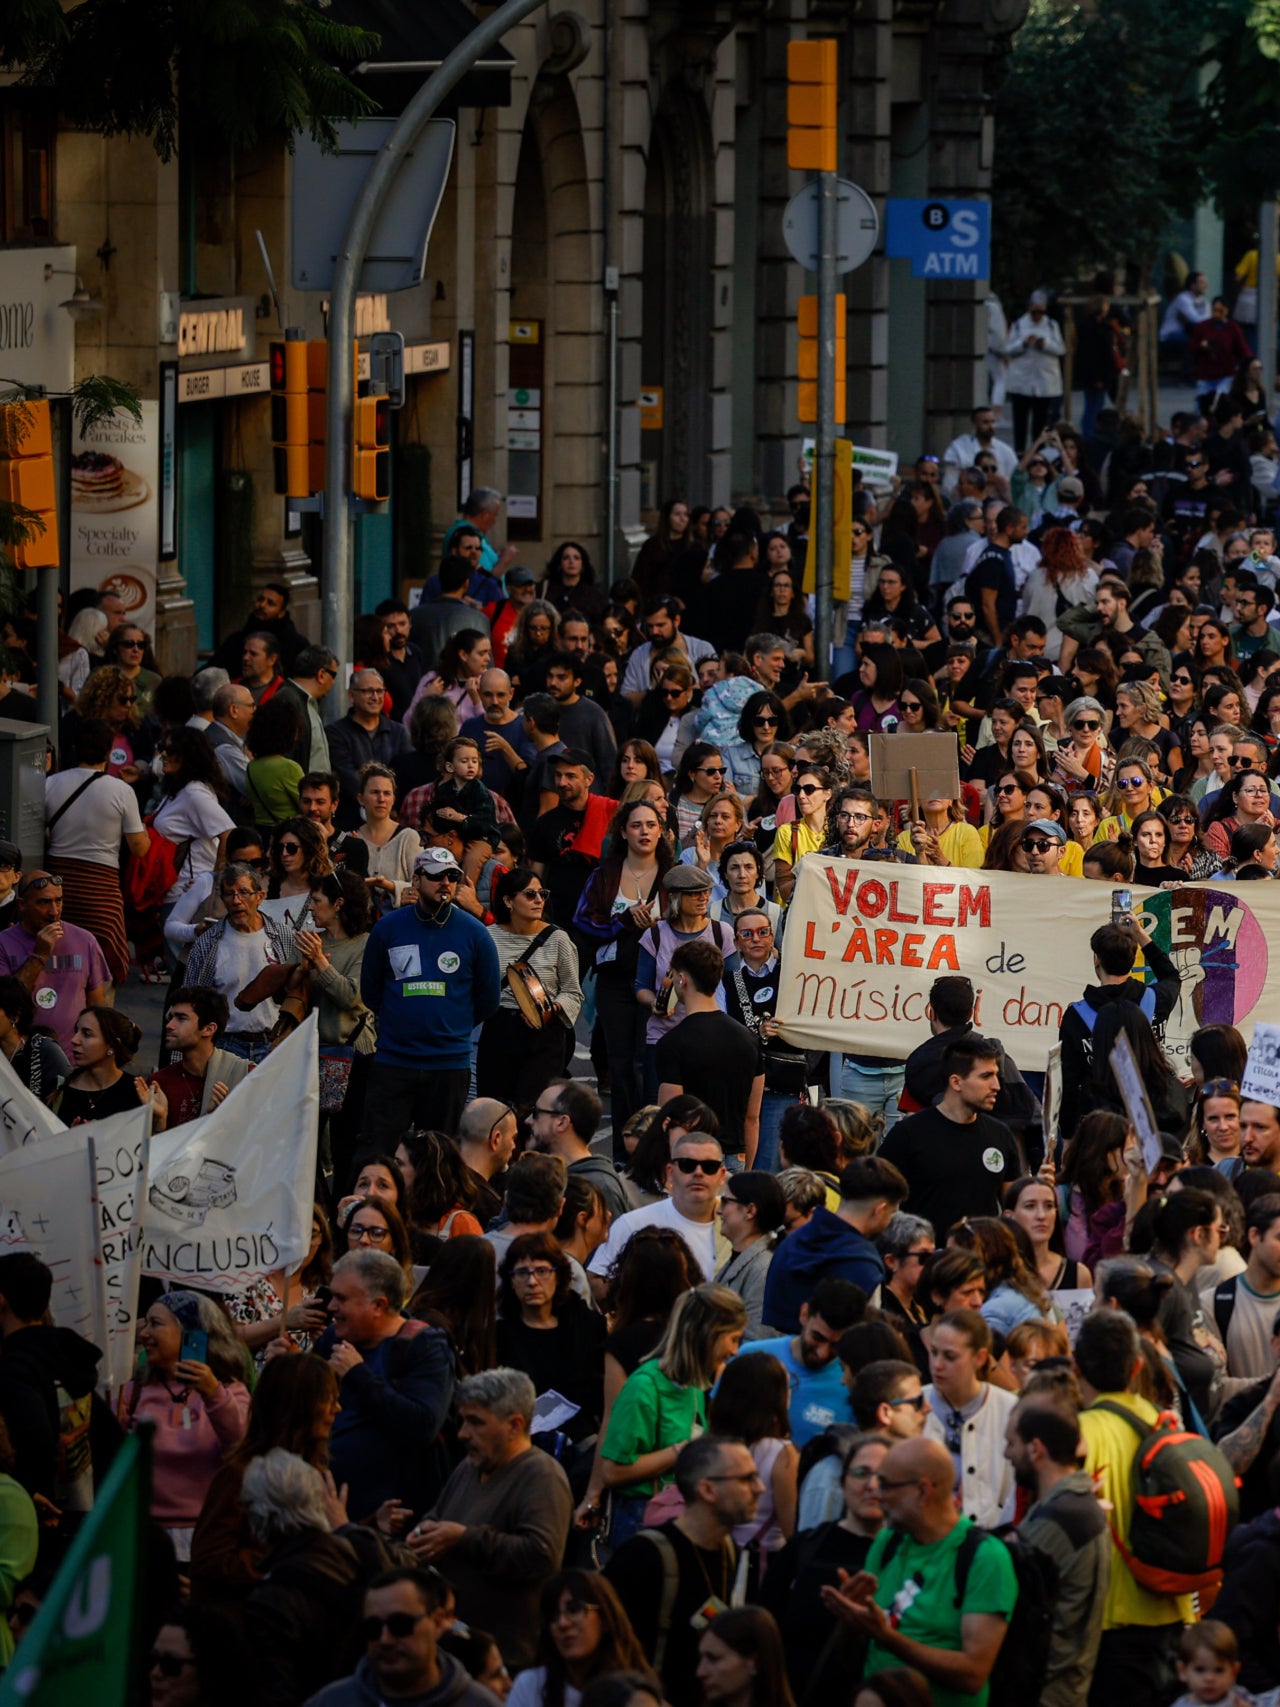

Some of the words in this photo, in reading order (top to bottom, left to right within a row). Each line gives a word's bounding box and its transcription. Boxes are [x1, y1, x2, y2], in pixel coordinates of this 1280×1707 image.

[924, 251, 979, 275] ATM
[178, 308, 247, 357] CENTRAL
[186, 375, 210, 396] BURGER
[241, 368, 261, 388] HOUSE
[78, 526, 139, 547] Specialty
[86, 540, 132, 558] Coffee
[824, 866, 992, 928] VOLEM
[804, 915, 961, 971] L'ÀREA
[985, 941, 1027, 974] de
[796, 972, 928, 1022] Músic
[1003, 986, 1065, 1028] dan
